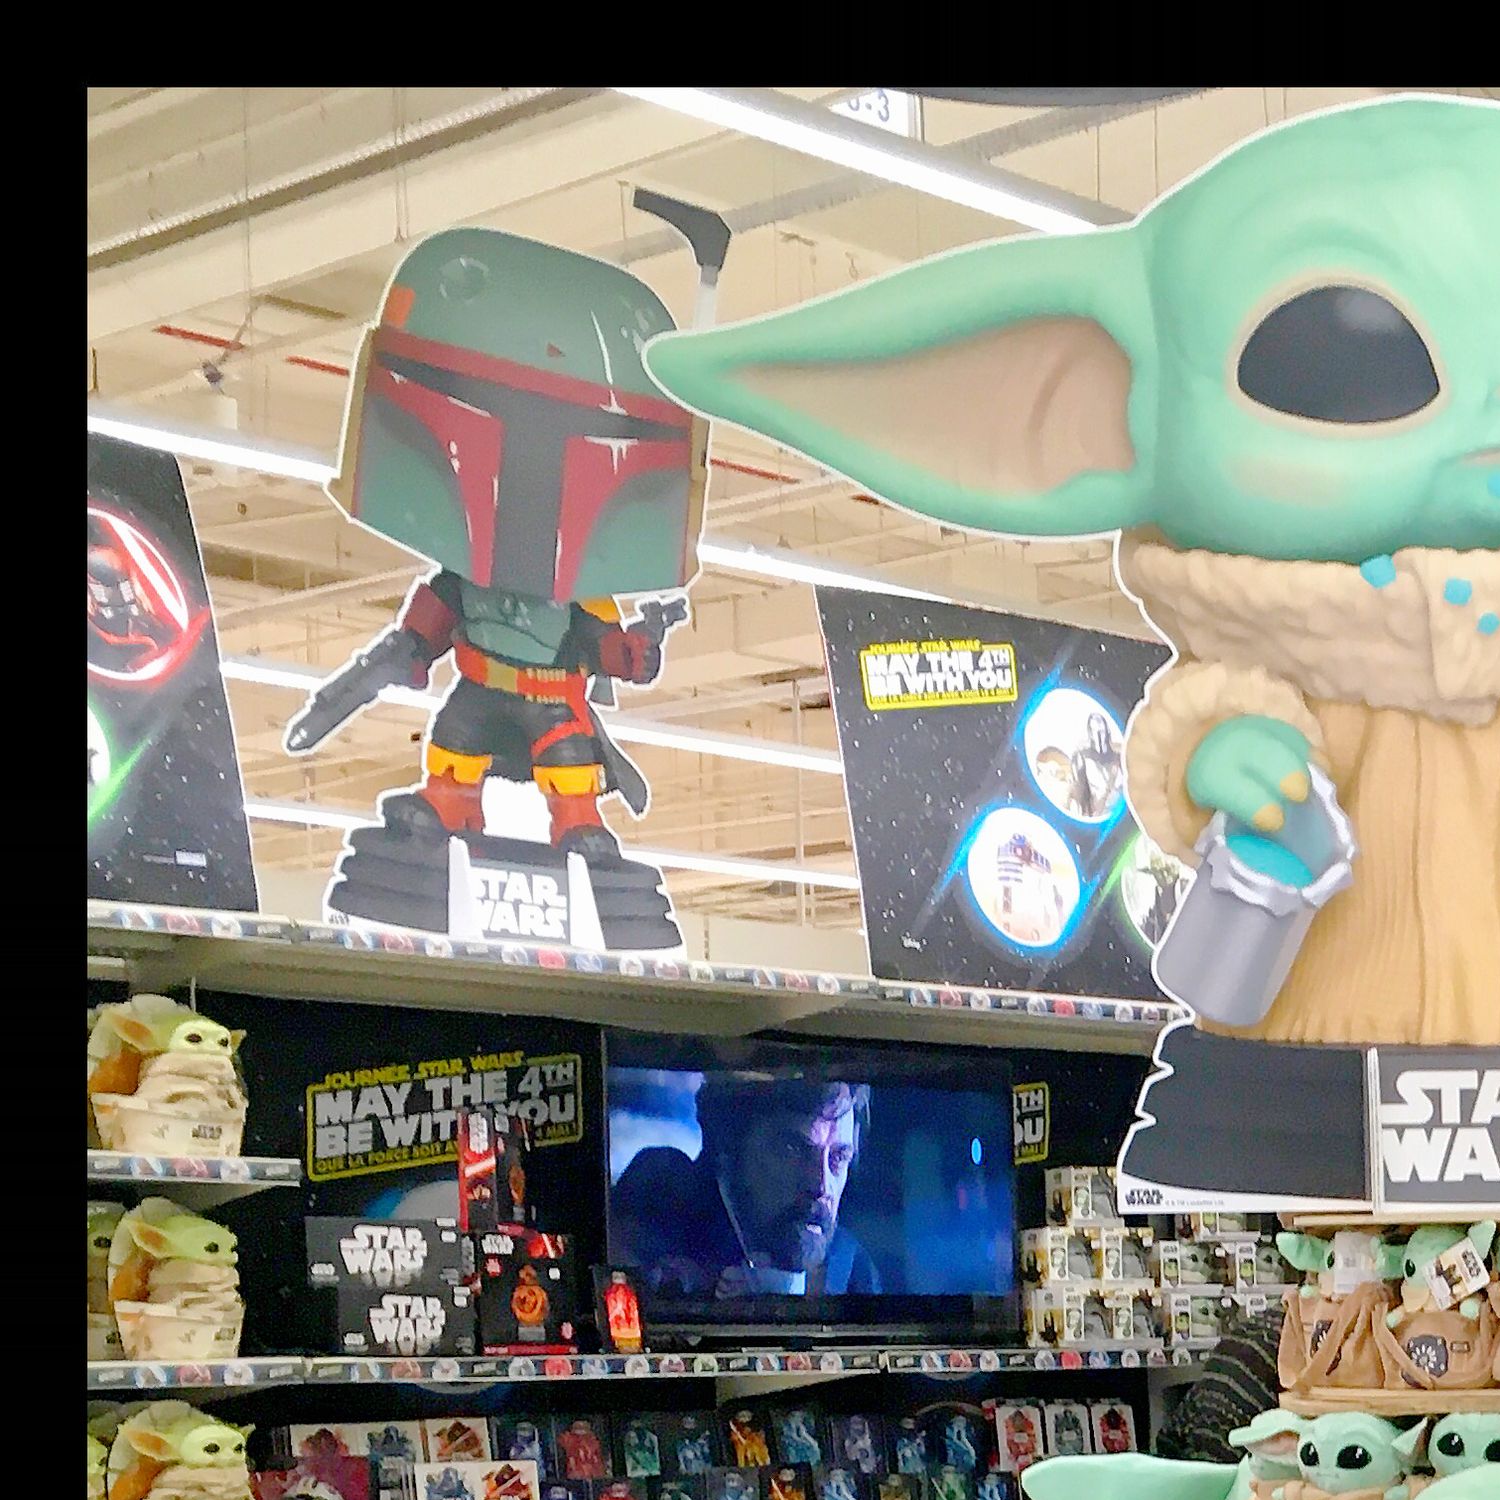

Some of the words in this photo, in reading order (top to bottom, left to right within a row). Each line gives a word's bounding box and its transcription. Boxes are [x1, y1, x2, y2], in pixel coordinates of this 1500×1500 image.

[866, 652, 919, 676] MAY
[926, 650, 974, 674] THE
[978, 648, 1010, 672] 4TH
[867, 673, 901, 697] BE
[901, 669, 965, 695] WITH
[966, 668, 1012, 691] YOU
[414, 1058, 467, 1080] STAR
[469, 1050, 525, 1071] WARS
[314, 1081, 413, 1127] MAY
[424, 1069, 508, 1110] THE
[517, 1062, 575, 1099] 4TH
[314, 1120, 374, 1159] BE
[380, 1106, 464, 1149] WIT
[1125, 1194, 1162, 1206] WARS
[1128, 1188, 1163, 1200] STAR
[340, 1224, 427, 1256] STAR
[341, 1249, 425, 1275] WARS
[369, 1294, 446, 1325] STAR
[370, 1317, 445, 1345] WARS
